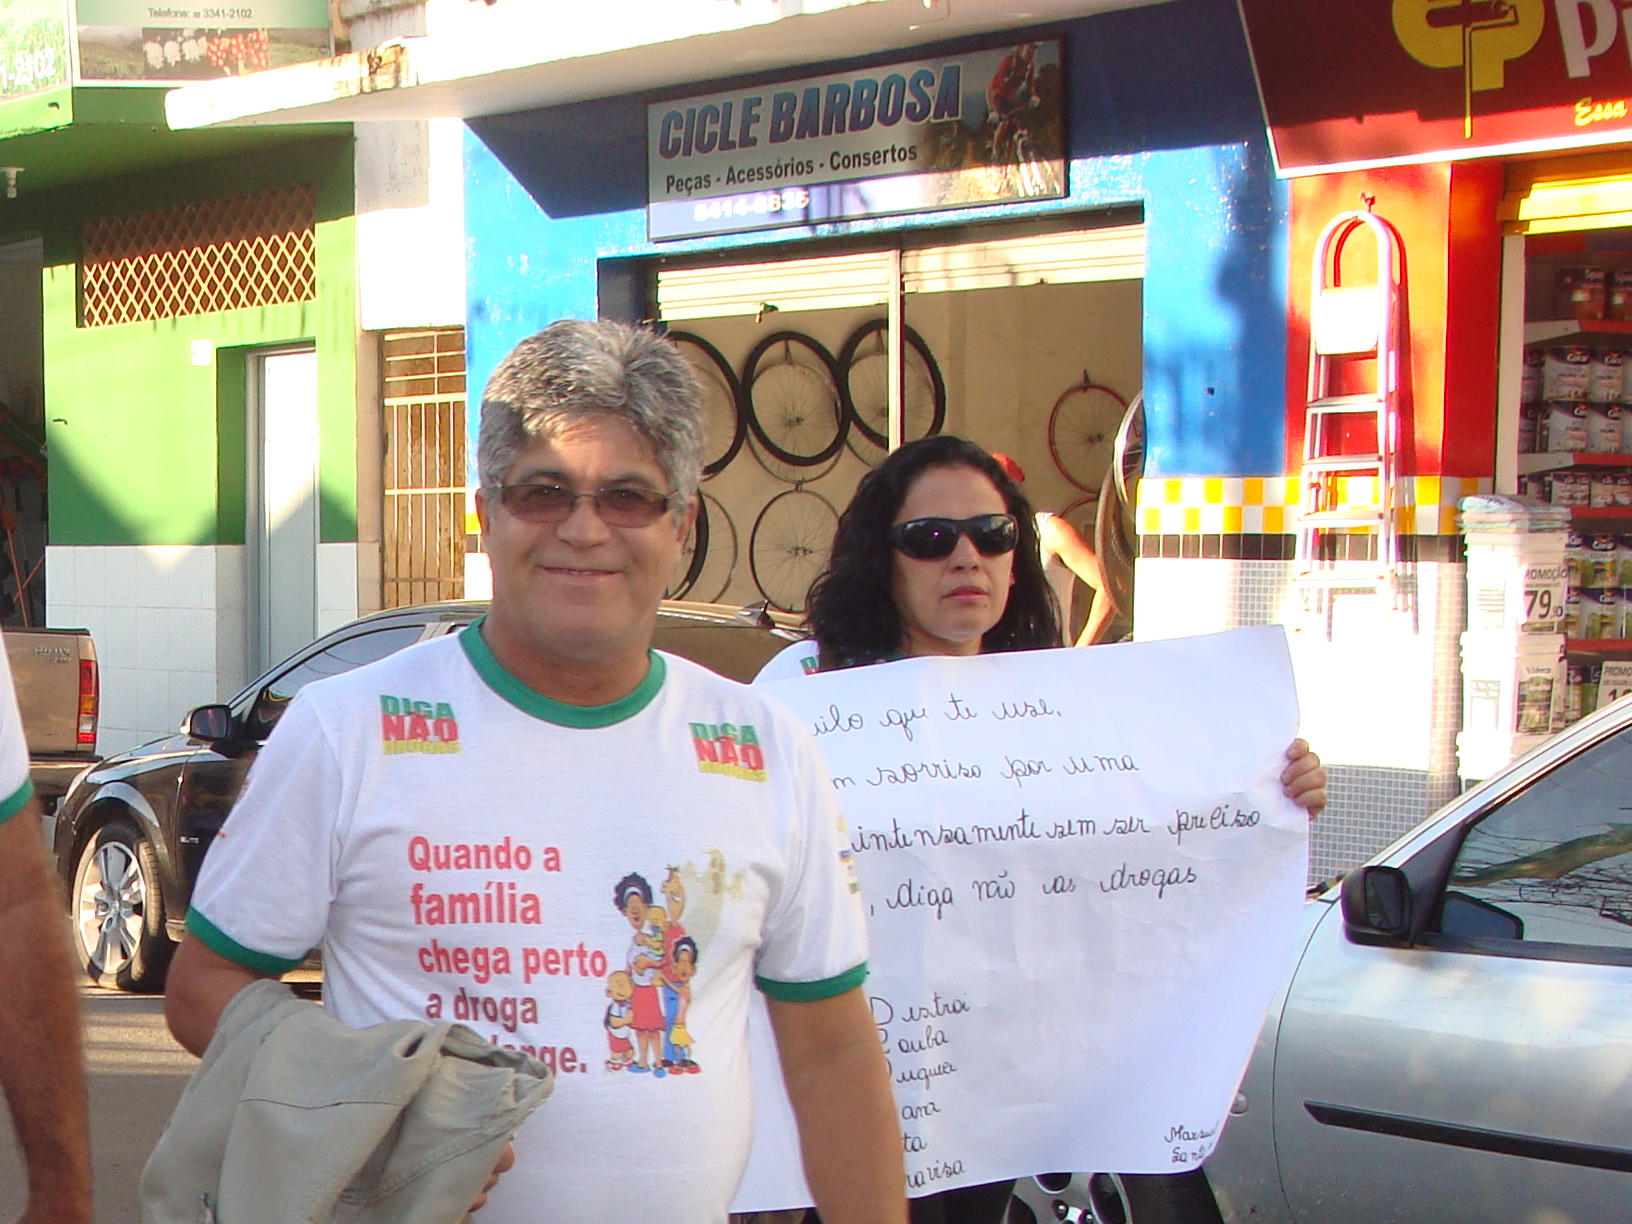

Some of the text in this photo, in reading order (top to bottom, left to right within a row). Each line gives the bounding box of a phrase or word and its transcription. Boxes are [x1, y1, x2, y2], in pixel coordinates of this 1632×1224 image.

[203, 8, 253, 18] 3341-2102
[659, 63, 963, 161] CICLE BARBOSA
[1574, 97, 1628, 126] Essa
[666, 173, 712, 196] Peças
[725, 157, 815, 186] Acessórios
[829, 143, 919, 171] Consertos
[379, 694, 455, 720] DIGA
[382, 711, 459, 743] NÃO
[688, 722, 759, 746] DIGA
[693, 735, 764, 770] NÃO
[1063, 754, 1141, 776] uma
[408, 835, 562, 873] Quando a
[410, 880, 542, 925] família
[885, 878, 954, 921] diga
[1099, 863, 1198, 901] drogas
[418, 939, 607, 984] chega perto
[425, 986, 539, 1033] a droga
